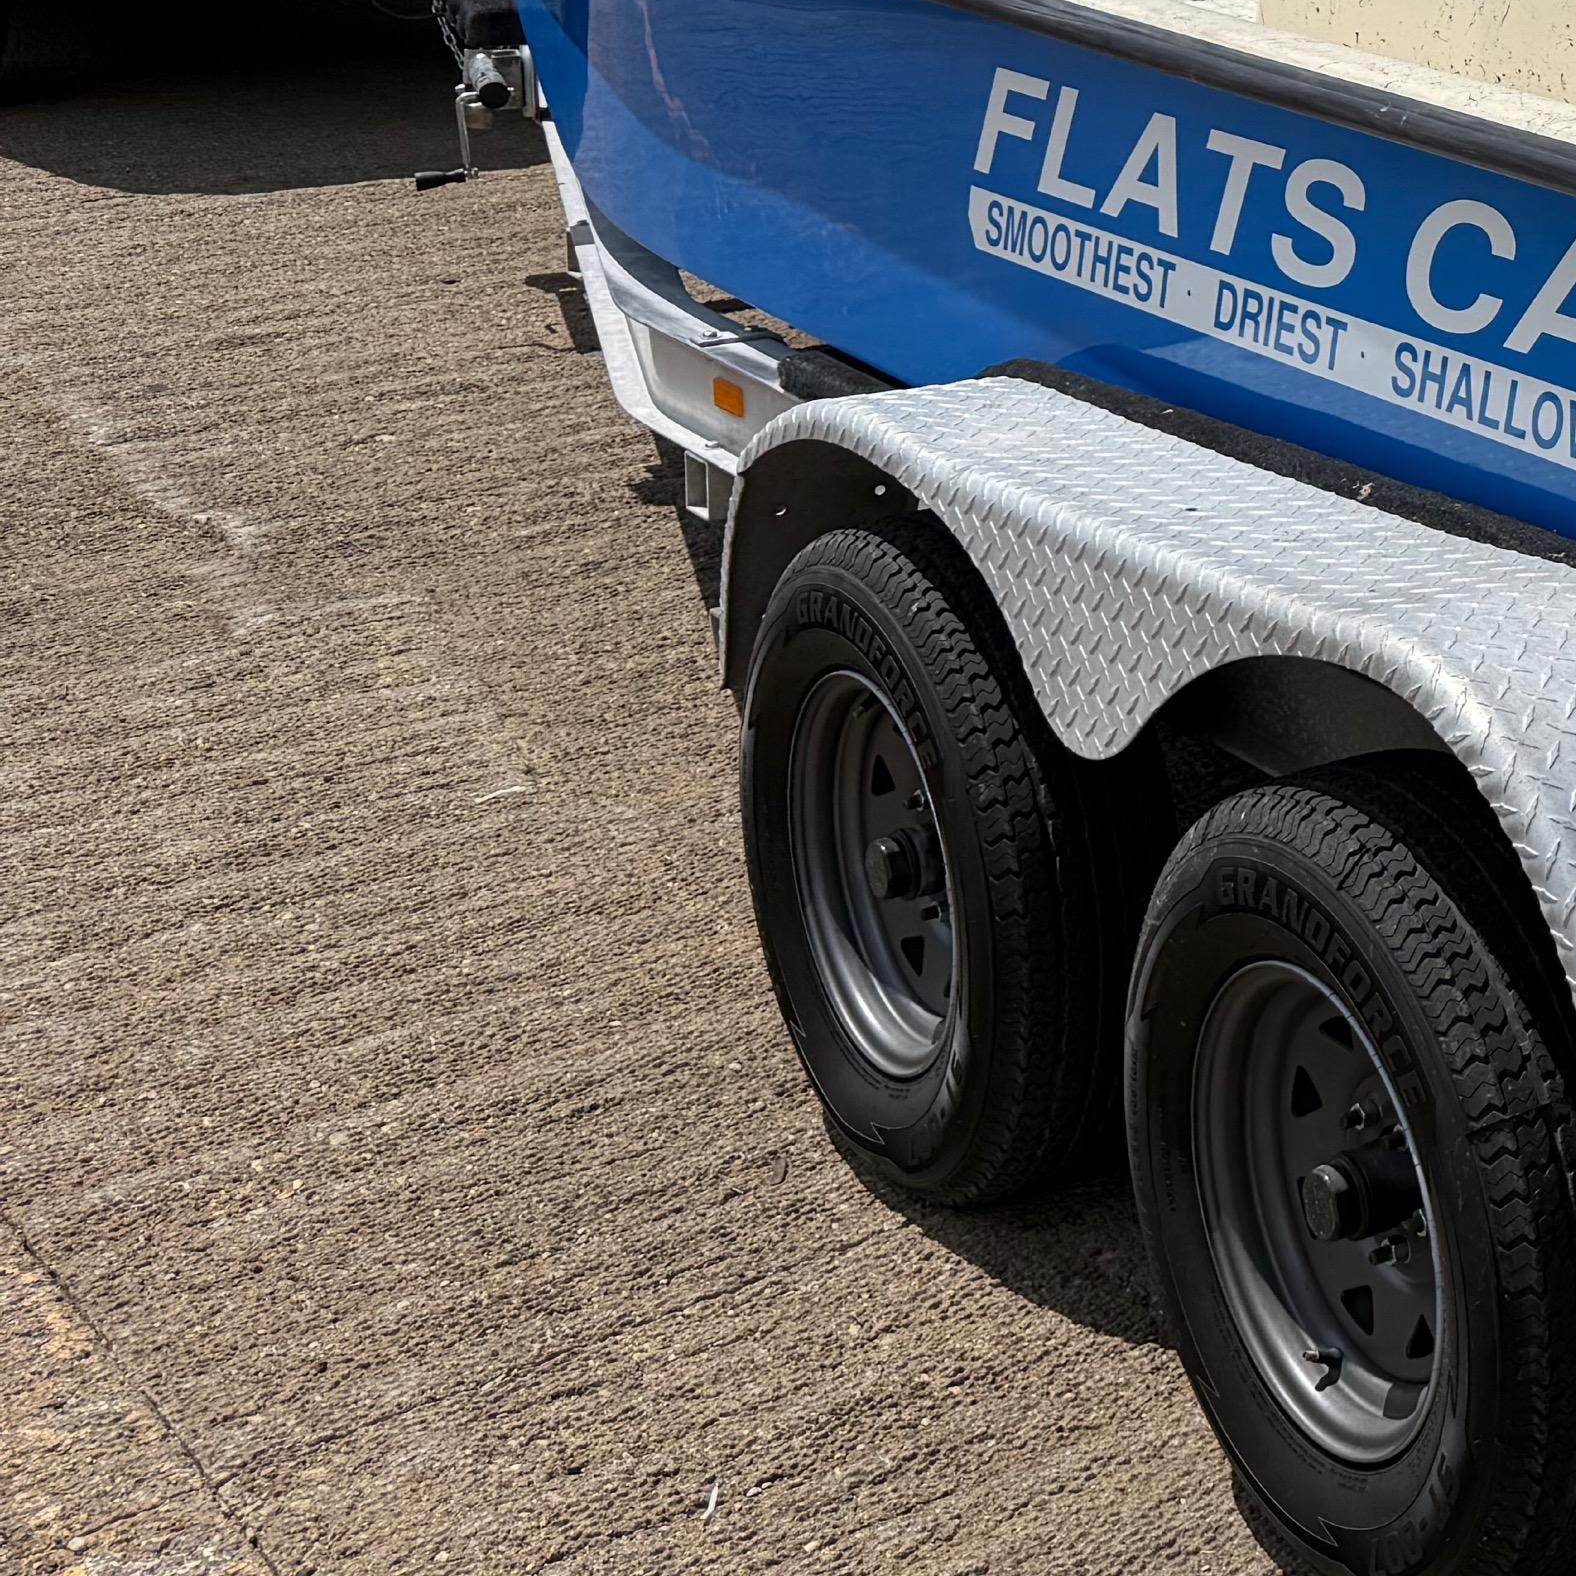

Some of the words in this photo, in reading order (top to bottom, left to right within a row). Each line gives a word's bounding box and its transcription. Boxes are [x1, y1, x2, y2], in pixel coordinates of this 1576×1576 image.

[973, 67, 1366, 288] FLATS
[985, 200, 1176, 309] SMOOTHEST
[1214, 279, 1348, 371] DRIEST
[795, 590, 939, 770] GRANDFORCE
[1216, 865, 1429, 1108] GRANDFORCE
